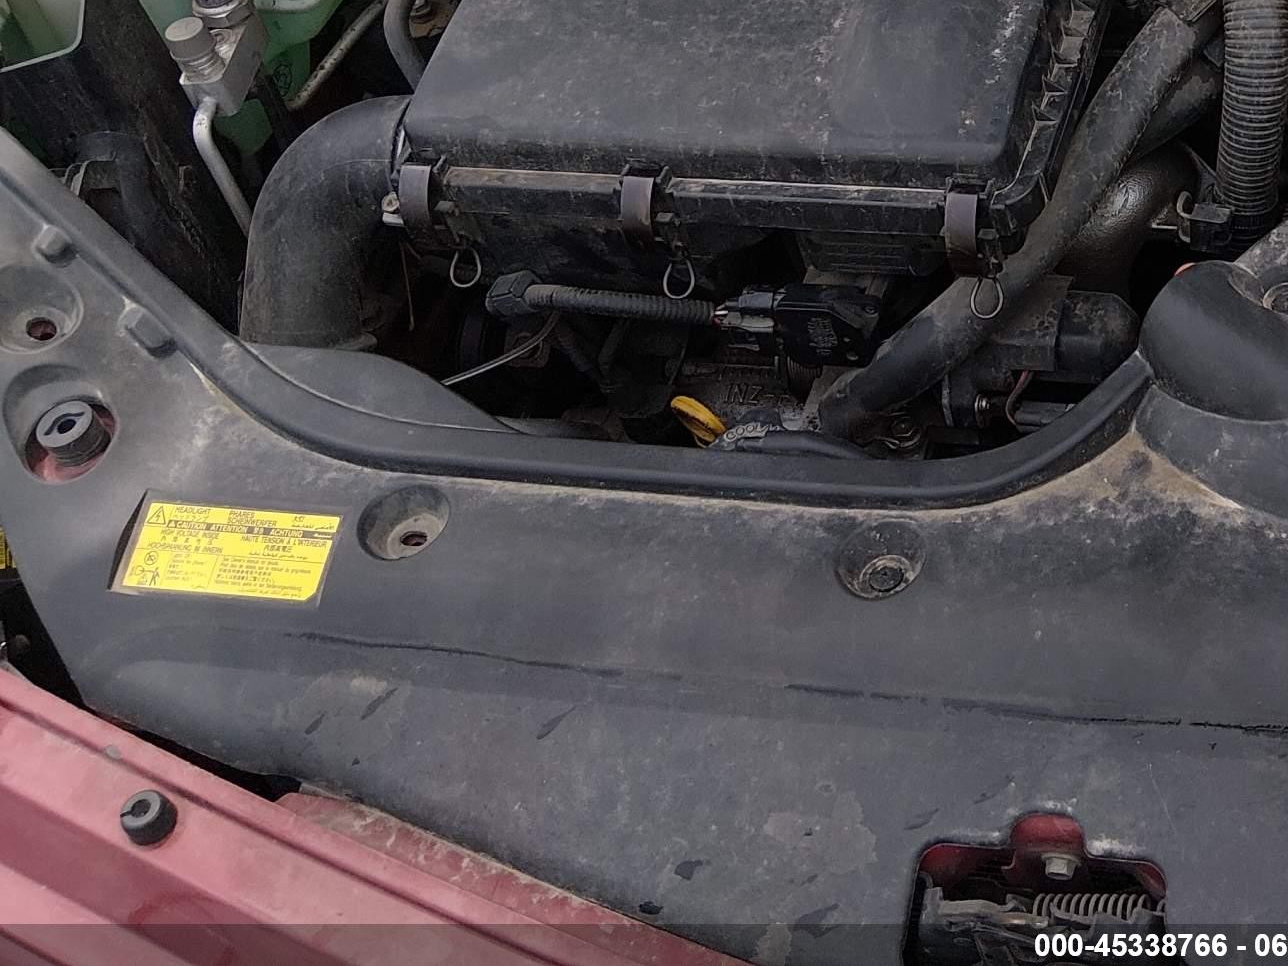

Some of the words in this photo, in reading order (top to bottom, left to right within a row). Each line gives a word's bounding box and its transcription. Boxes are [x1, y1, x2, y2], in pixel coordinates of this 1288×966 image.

[175, 505, 212, 516] HEADLIGHT
[177, 521, 207, 531] CAUTION
[210, 524, 248, 534] ATTENTION
[270, 528, 304, 538] ACHTUNG
